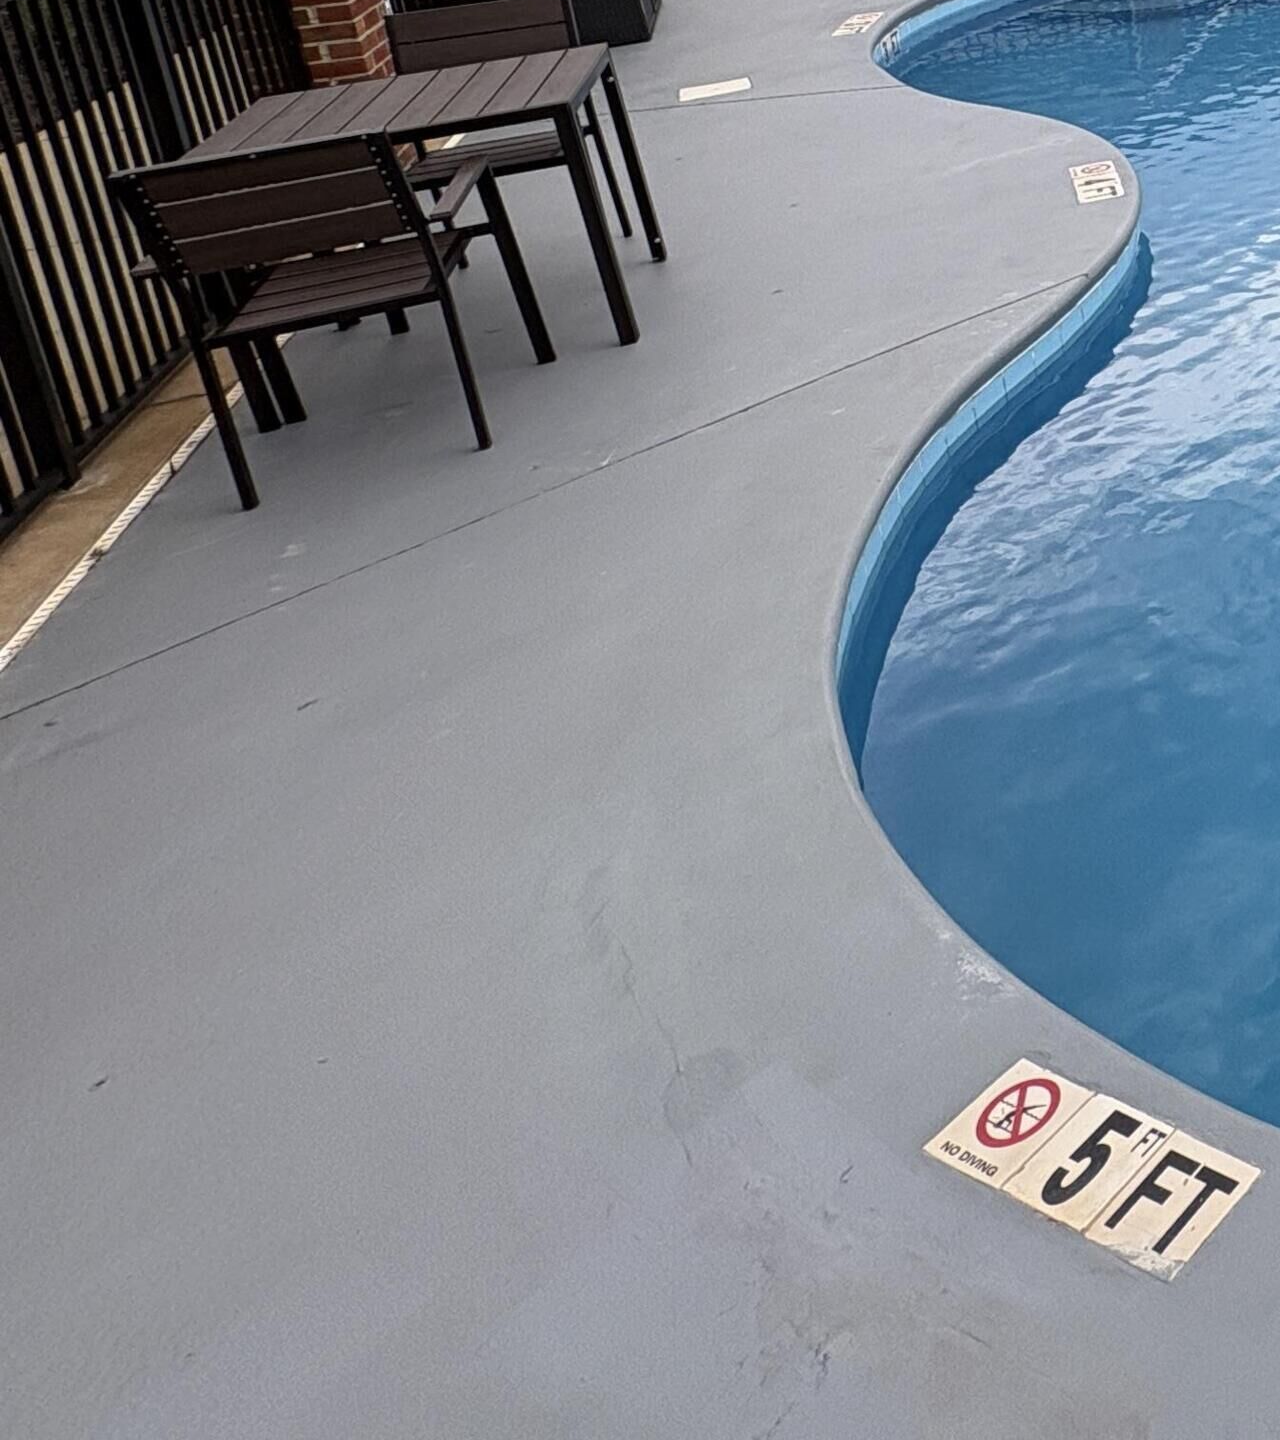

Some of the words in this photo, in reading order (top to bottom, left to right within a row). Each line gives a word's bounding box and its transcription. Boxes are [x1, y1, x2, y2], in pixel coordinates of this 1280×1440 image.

[939, 1140, 960, 1162] NO
[959, 1149, 999, 1178] DIVING
[1041, 1110, 1143, 1206] 5
[1103, 1150, 1240, 1256] FT
